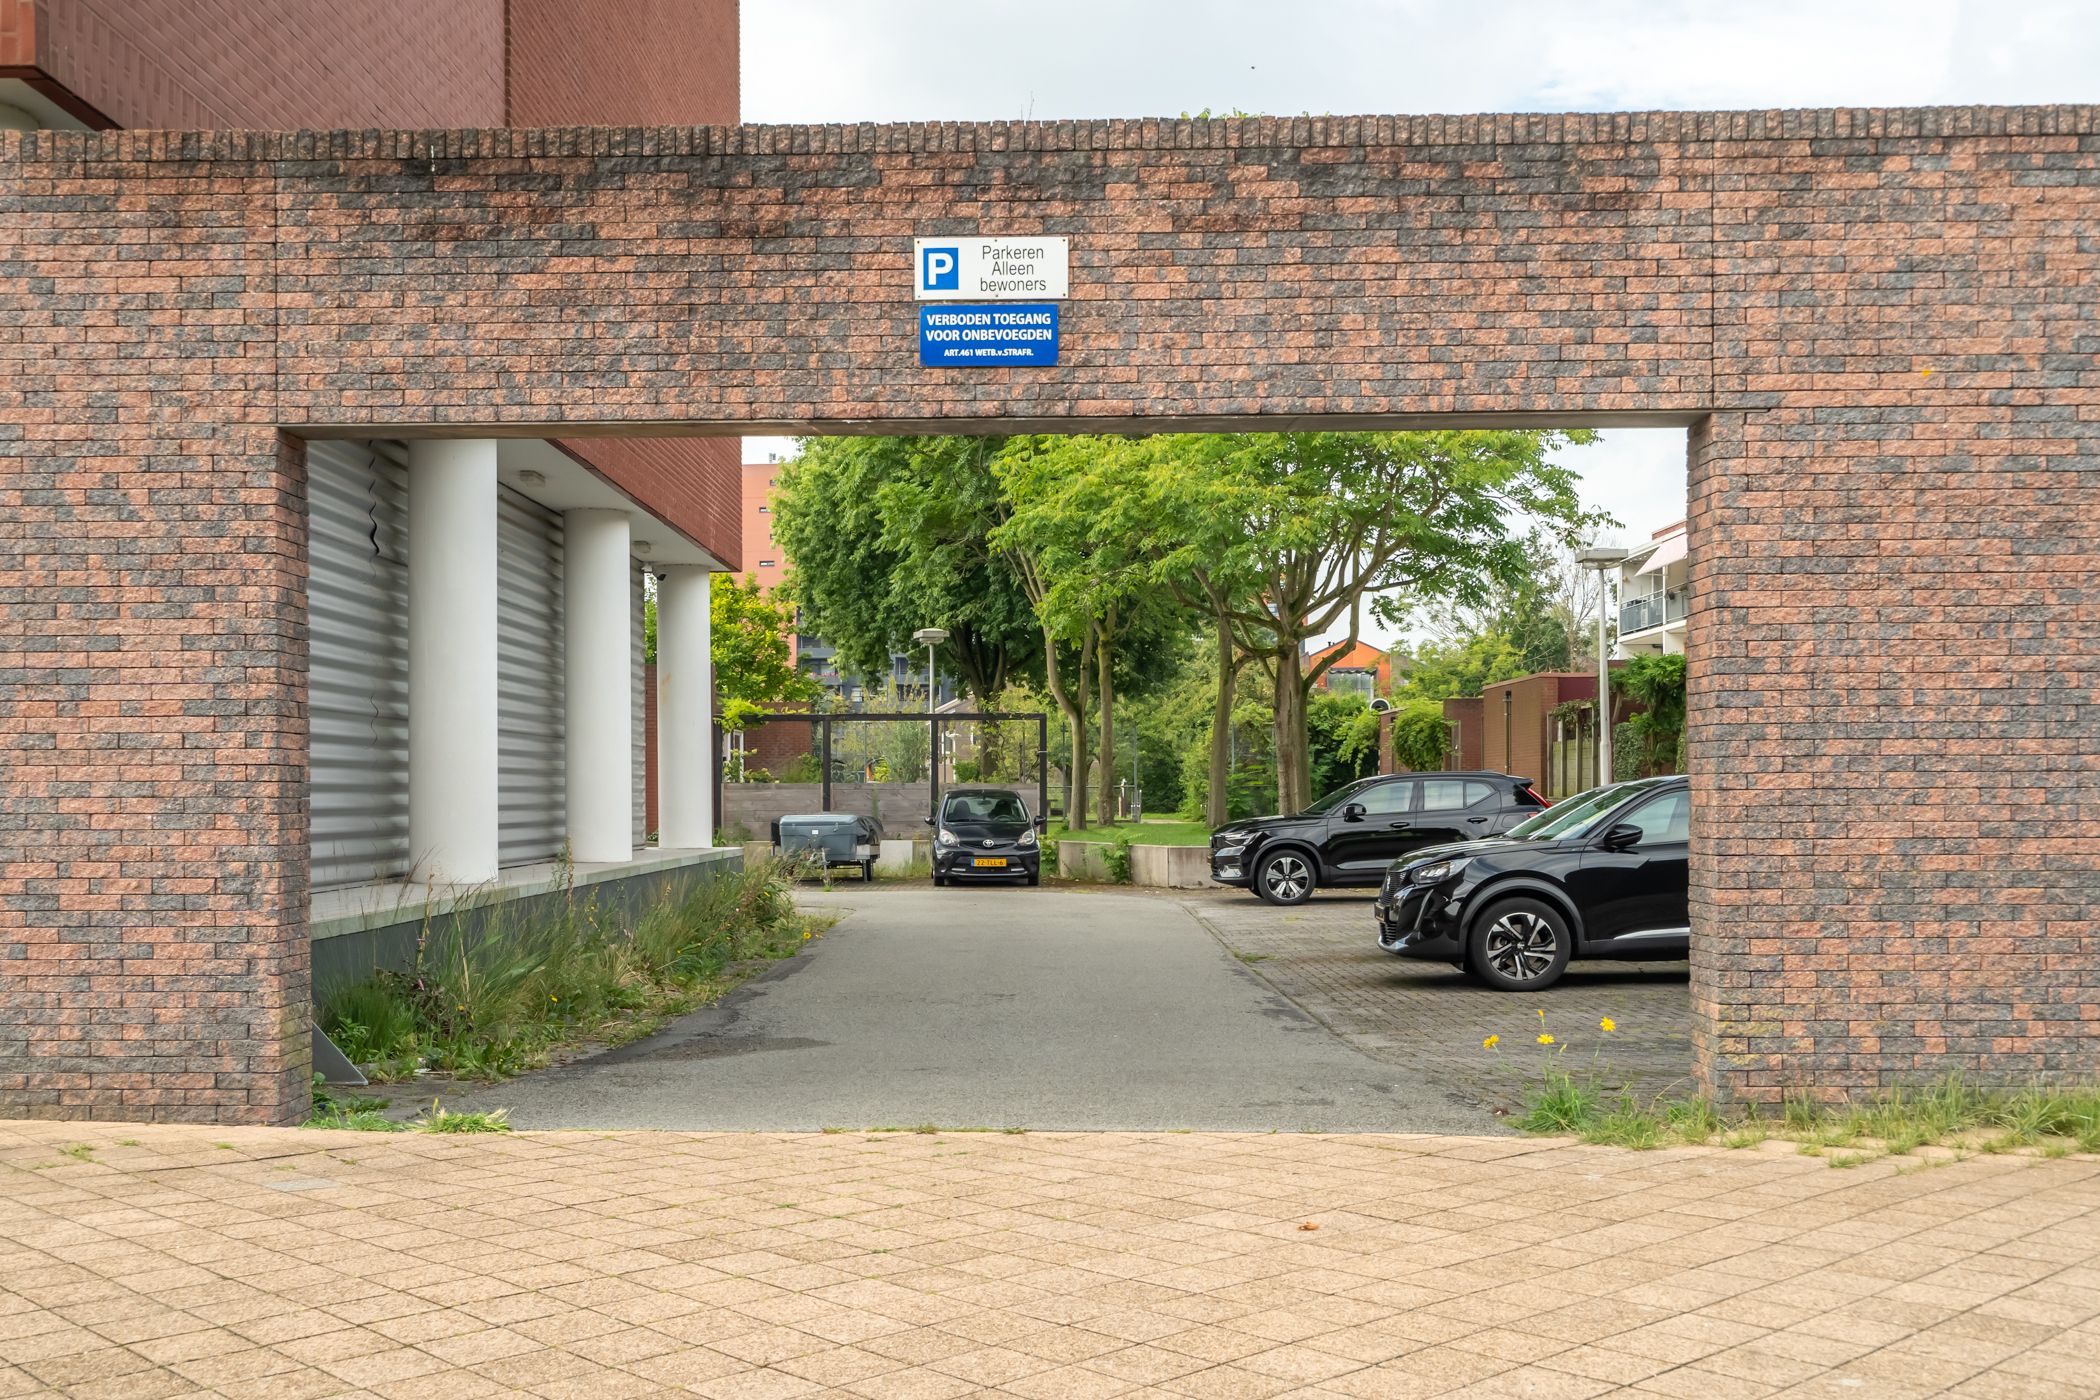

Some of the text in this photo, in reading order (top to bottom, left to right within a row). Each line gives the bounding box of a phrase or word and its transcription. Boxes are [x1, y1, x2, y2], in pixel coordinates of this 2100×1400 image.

[982, 245, 1044, 260] Parkeren
[928, 253, 953, 285] P
[991, 261, 1034, 275] Alleen
[980, 278, 1047, 292] bewoners
[926, 313, 1051, 326] VERBODEN TOEGANG
[926, 329, 1052, 341] VOOR ONBEVOEGDEN
[943, 349, 973, 357] ART.461
